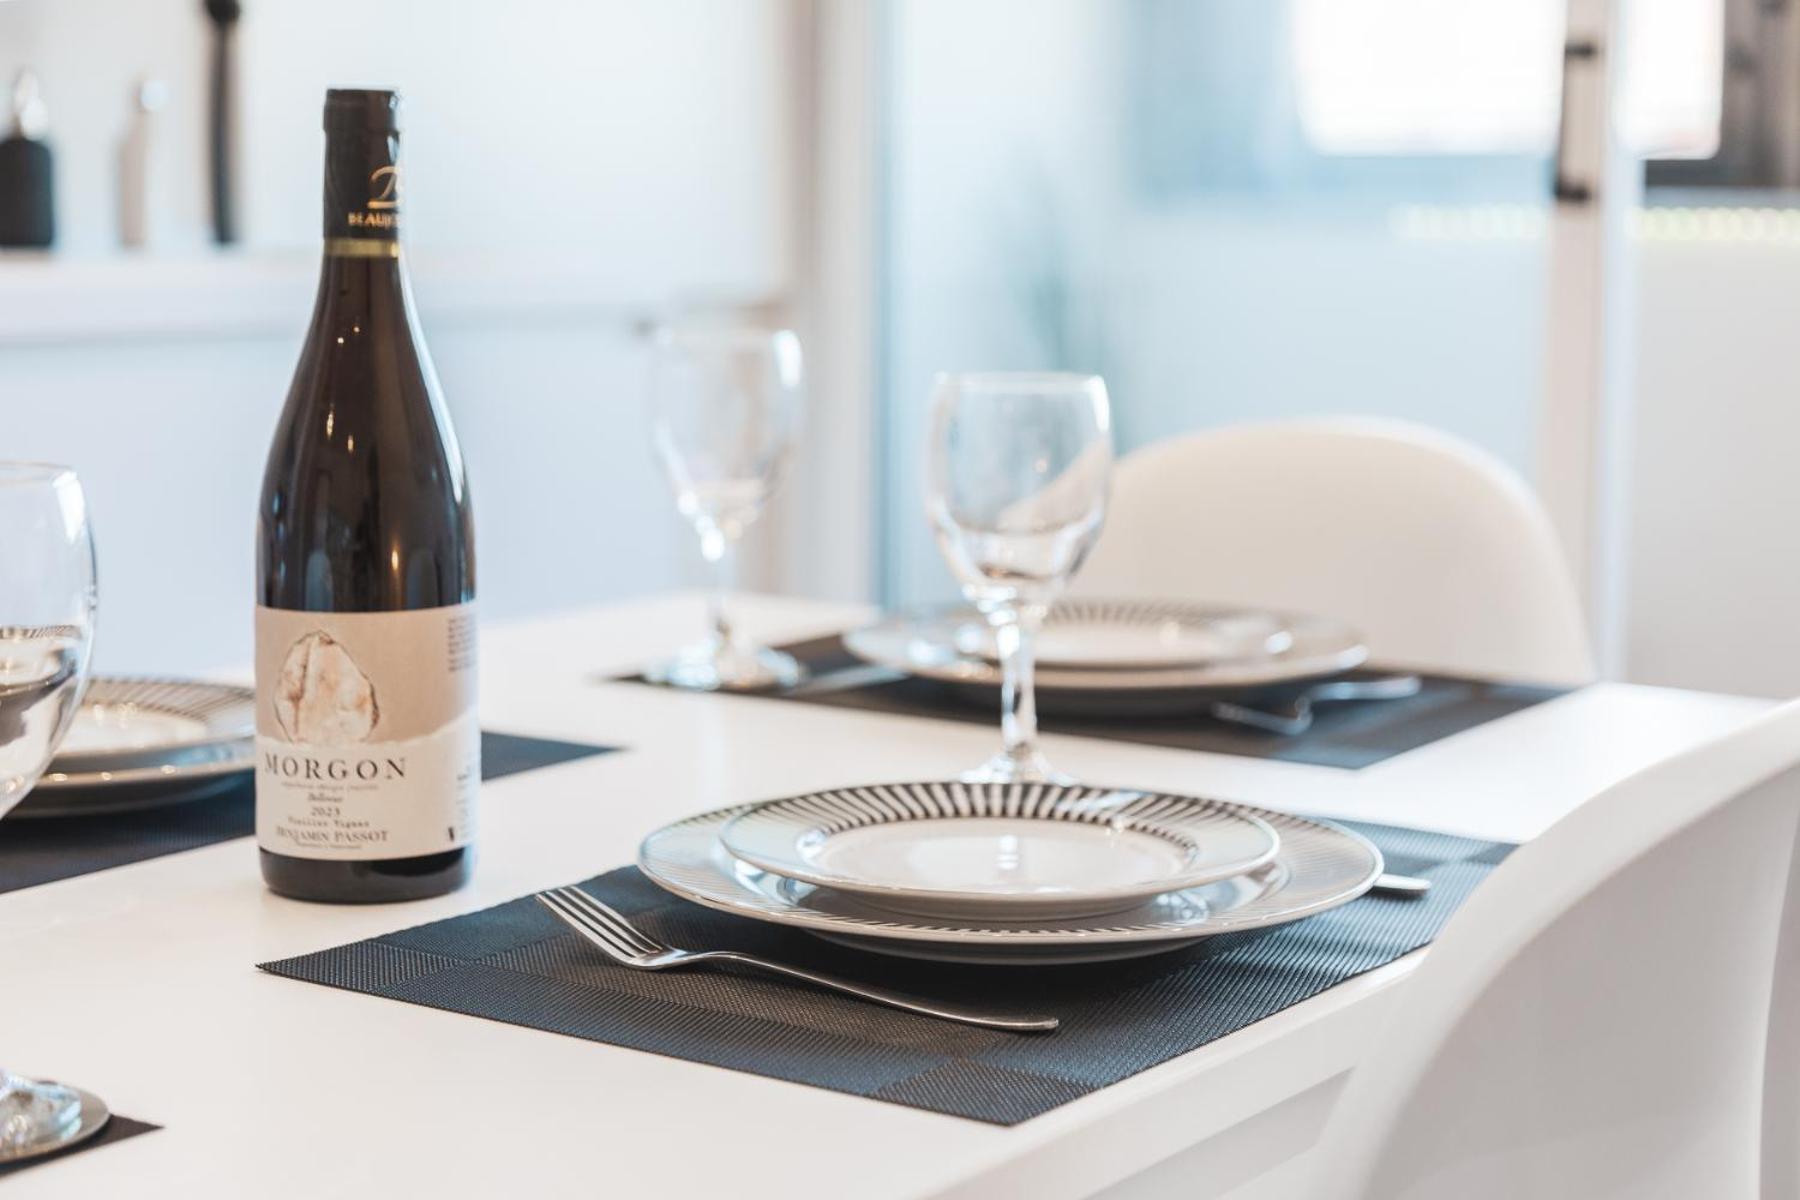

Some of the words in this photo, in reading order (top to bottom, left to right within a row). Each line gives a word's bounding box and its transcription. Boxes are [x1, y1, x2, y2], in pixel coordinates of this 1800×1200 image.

[265, 752, 406, 781] MORGON
[310, 806, 341, 817] 2023
[334, 830, 389, 842] PASSOT
